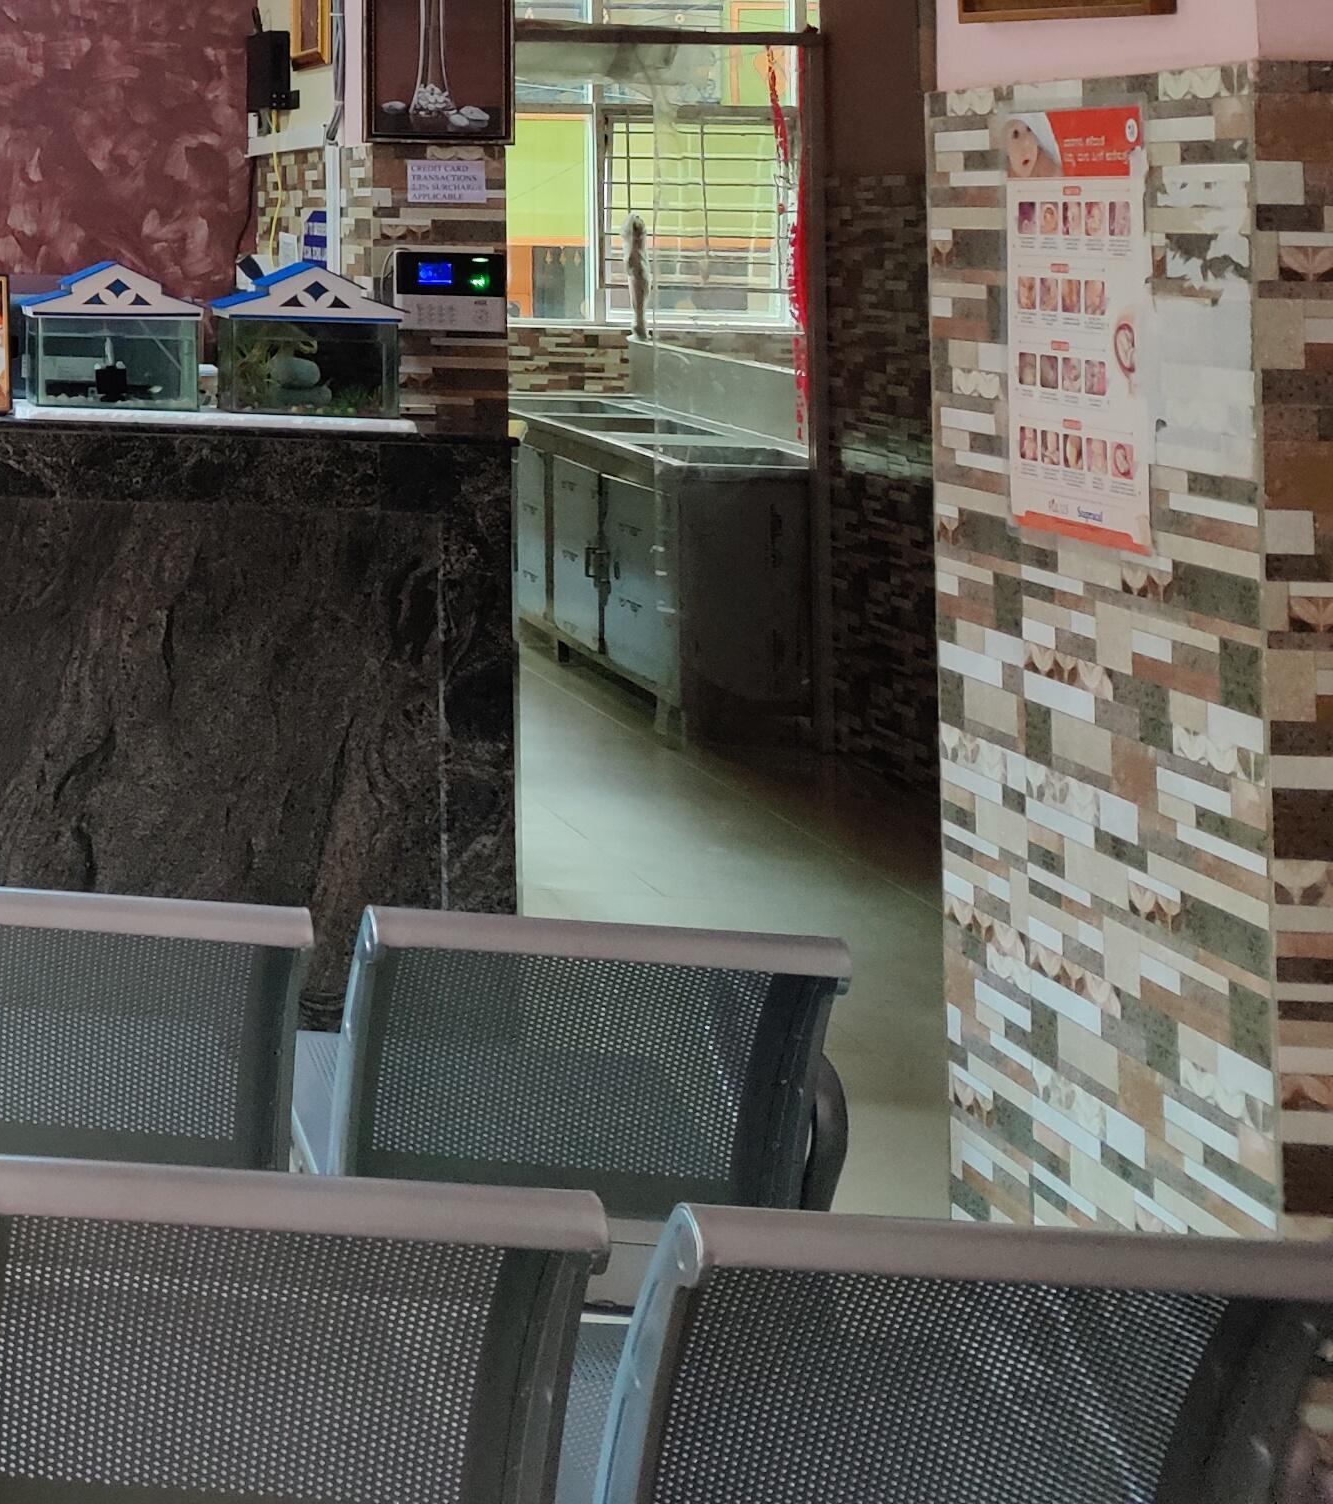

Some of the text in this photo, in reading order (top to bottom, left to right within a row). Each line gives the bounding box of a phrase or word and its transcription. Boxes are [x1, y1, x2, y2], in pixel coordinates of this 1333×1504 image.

[411, 165, 469, 173] CREDIT CARD
[411, 174, 477, 182] TRANSACTIONS
[431, 183, 482, 192] SURCHARGE
[411, 192, 463, 201] APPLICABLE
